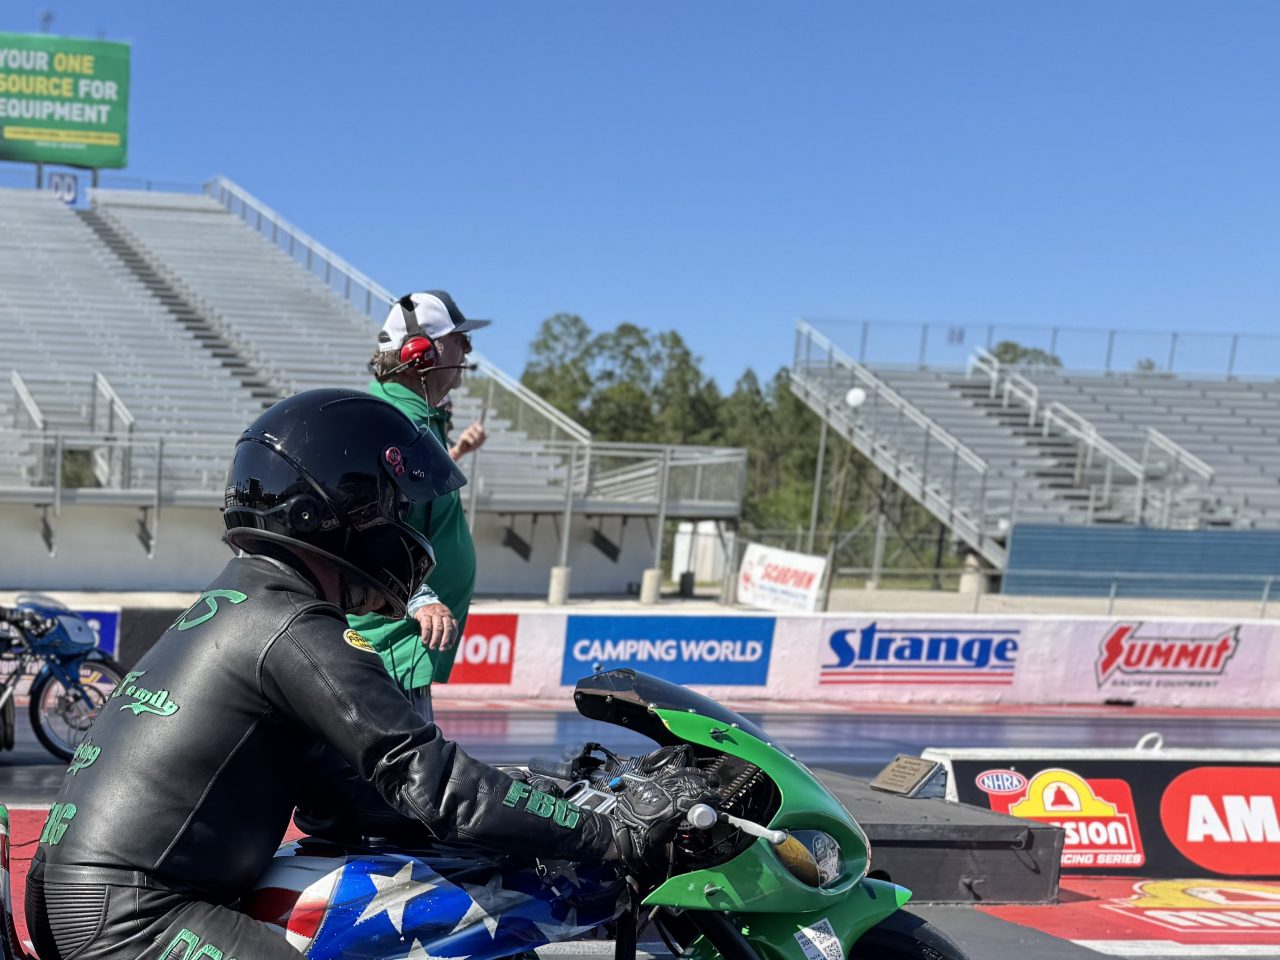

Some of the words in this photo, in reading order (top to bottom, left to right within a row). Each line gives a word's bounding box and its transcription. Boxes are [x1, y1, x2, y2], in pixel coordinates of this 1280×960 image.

[54, 53, 95, 75] ONE
[79, 80, 118, 101] FOR
[573, 639, 677, 662] CAMPING
[681, 640, 762, 662] WORLD
[829, 622, 1018, 668] Strange
[982, 775, 1021, 791] NHRA
[1096, 854, 1141, 864] SERIES
